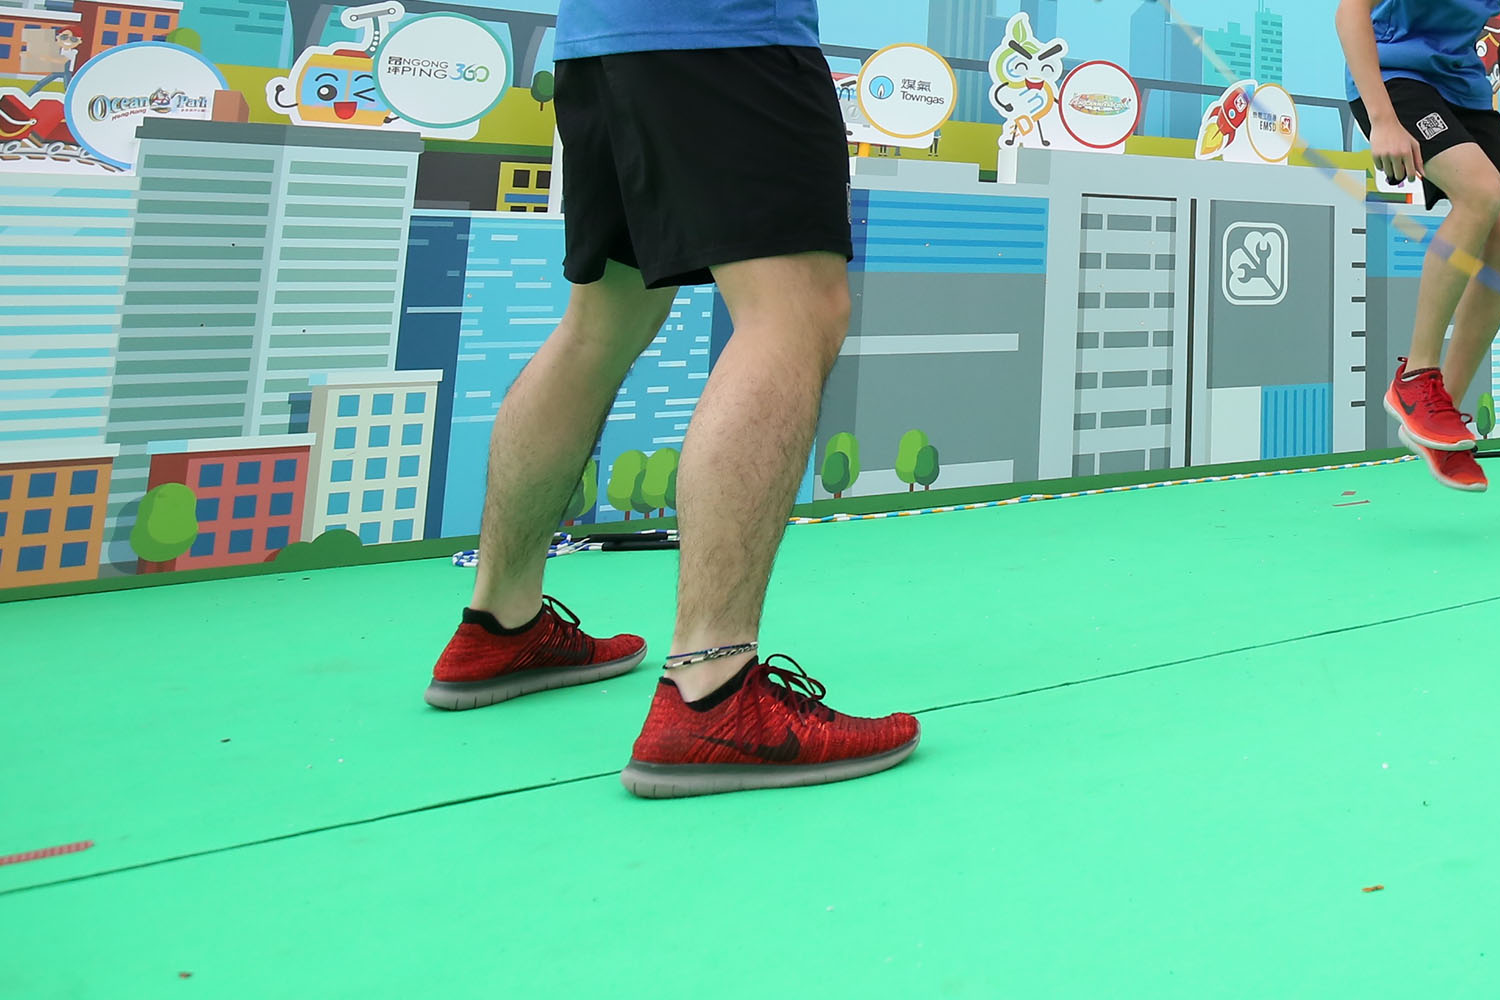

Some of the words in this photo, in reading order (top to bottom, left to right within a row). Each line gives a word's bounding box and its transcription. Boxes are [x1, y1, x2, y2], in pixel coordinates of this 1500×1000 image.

[401, 66, 447, 79] PING
[449, 63, 490, 82] 360
[901, 79, 931, 92] 煤氣
[900, 91, 945, 105] Towngas
[88, 95, 149, 121] Ocean
[1260, 121, 1277, 132] EMSD
